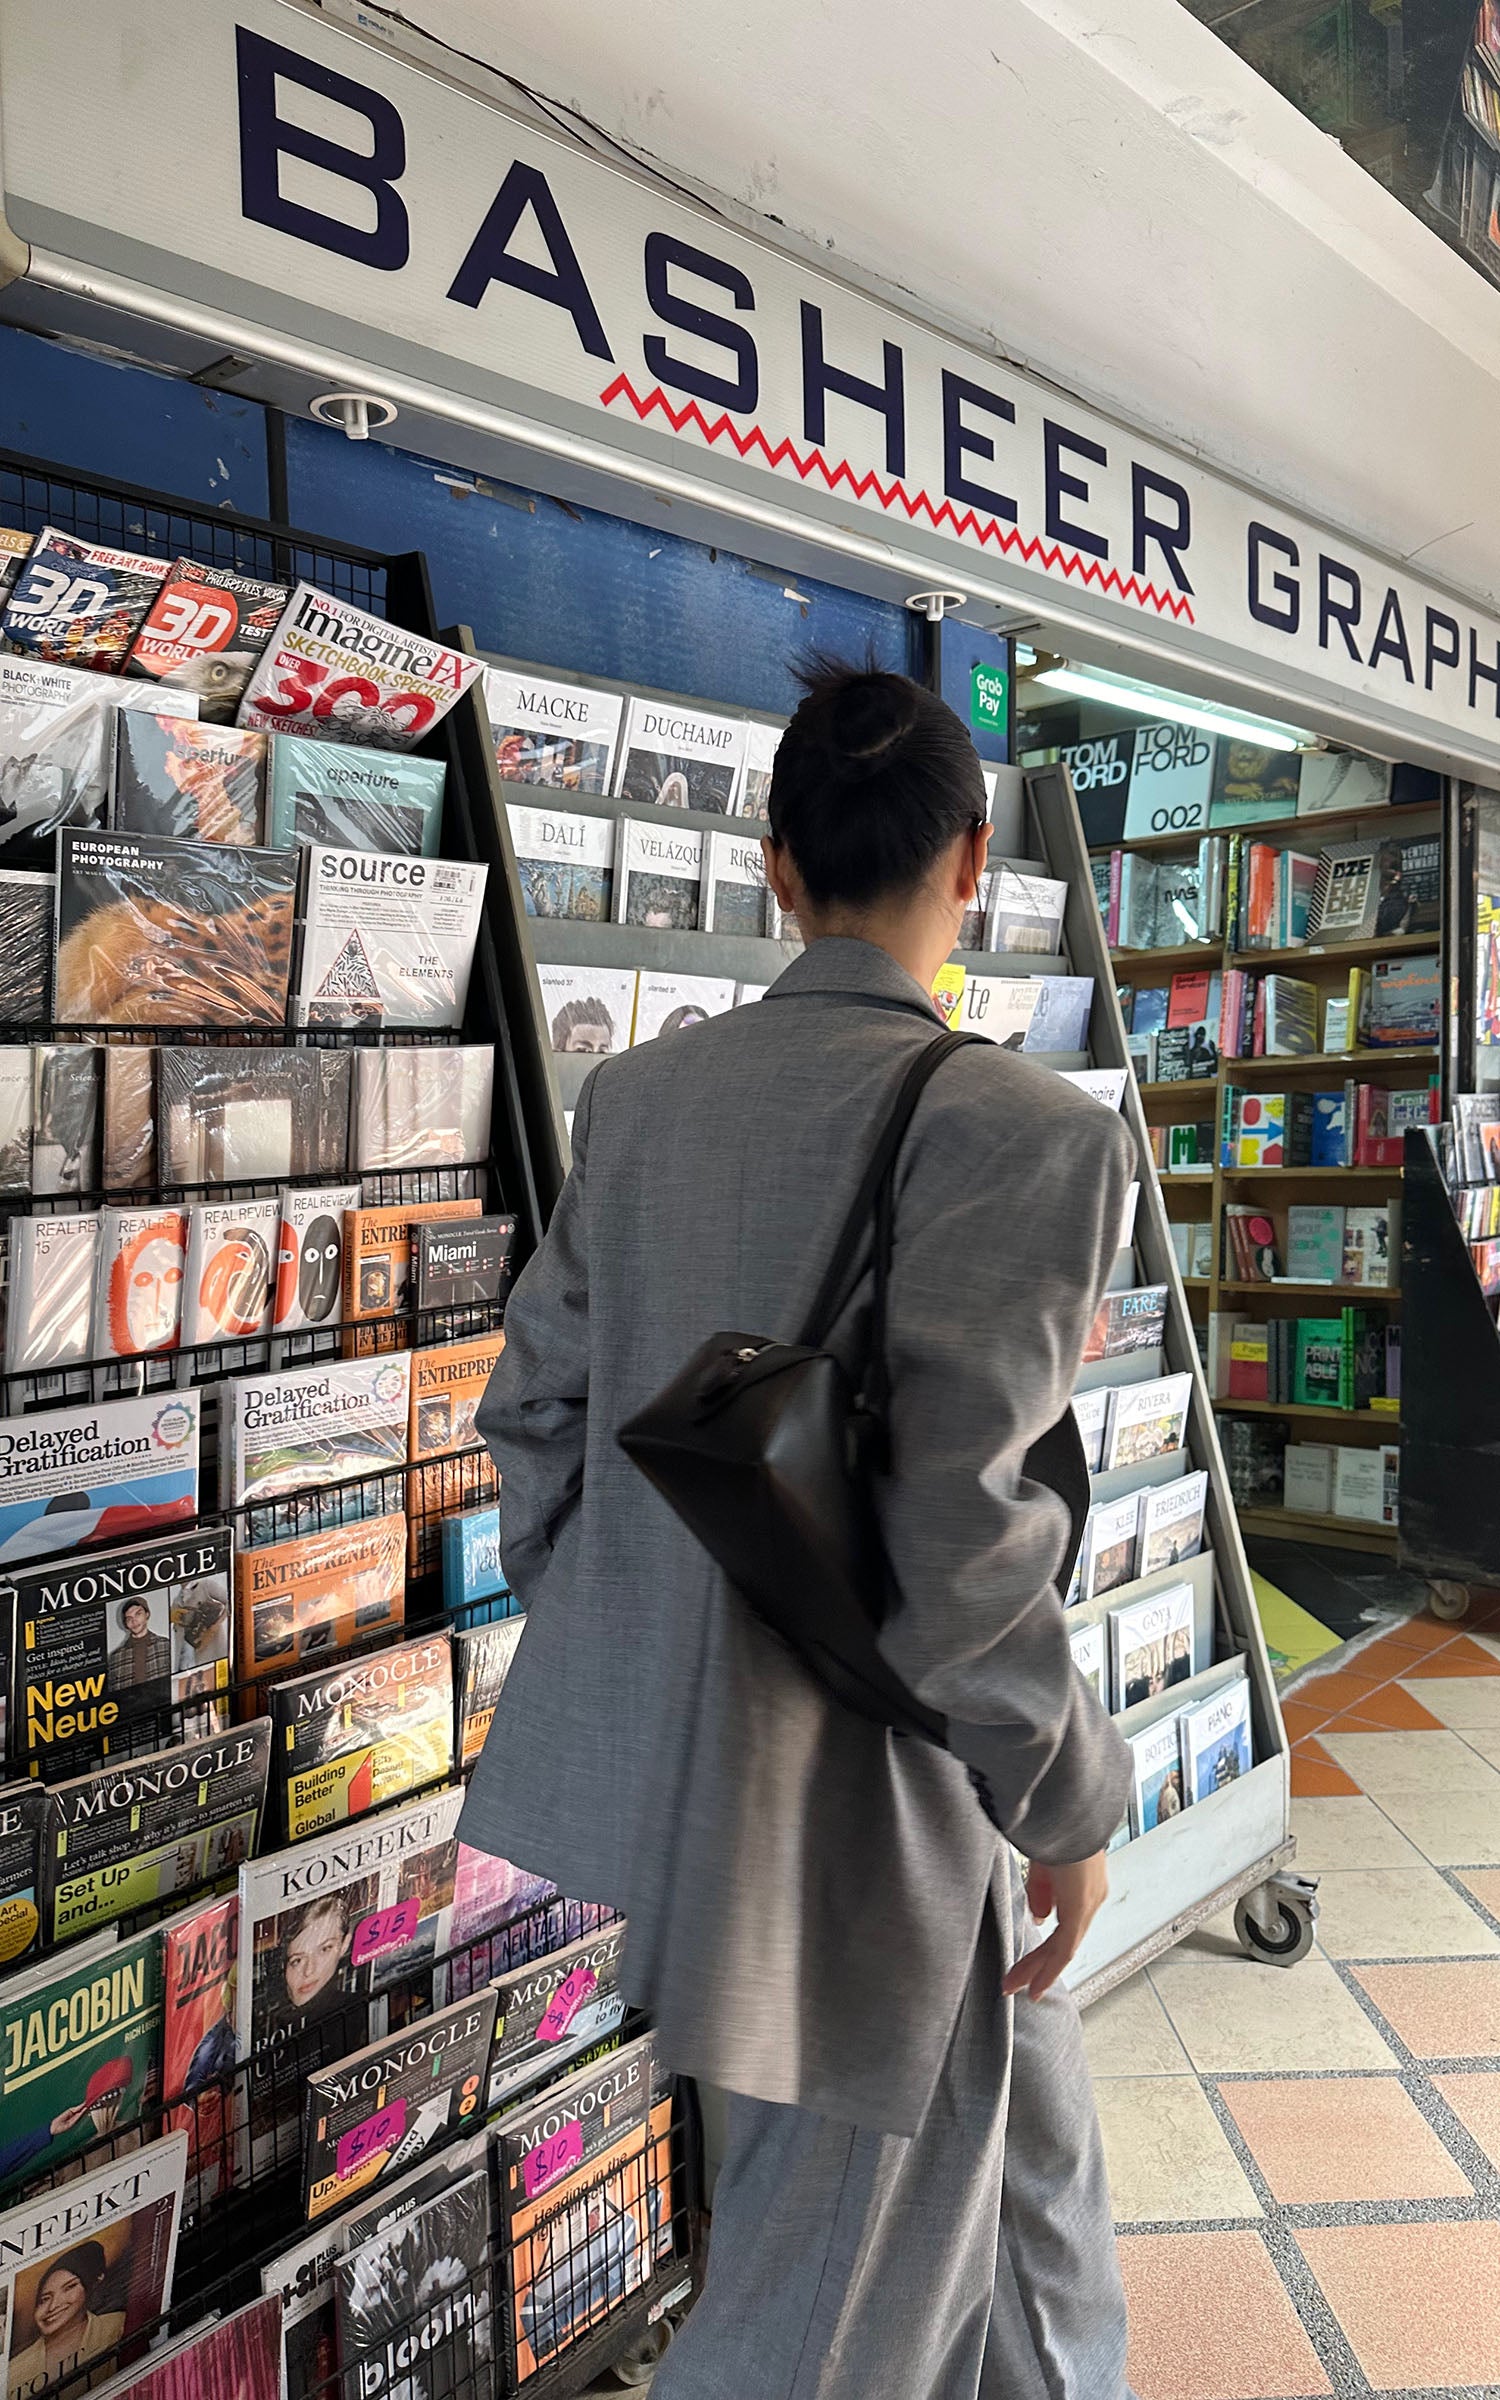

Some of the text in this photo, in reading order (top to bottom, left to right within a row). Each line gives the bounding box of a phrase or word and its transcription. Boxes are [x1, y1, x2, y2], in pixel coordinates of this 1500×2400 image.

[235, 24, 1500, 721] BASHEER GRAPH
[91, 550, 116, 566] FREE
[117, 555, 138, 571] ART
[139, 560, 172, 578] BOOKS
[7, 565, 109, 622] 3D
[9, 613, 66, 637] WORL
[140, 593, 232, 649] 3D
[239, 624, 273, 639] TEST
[339, 610, 439, 658] FOR DIGITAL ARTISTS
[278, 655, 300, 671] OVER
[283, 631, 457, 704] SKETCHBOOK SPECIAL!
[2, 681, 72, 701] PHOTOGRAPHY
[976, 673, 1003, 696] Grab
[517, 690, 589, 723] MACKE
[979, 691, 1000, 716] Pay
[247, 713, 320, 738] NEW SKETCHES!
[642, 714, 733, 749] DUCHAMP
[1138, 722, 1197, 752] TOM
[1061, 738, 1118, 766] TOM
[1135, 741, 1210, 776] FORD
[326, 767, 400, 790] aperture
[1069, 760, 1127, 792] ORD
[1151, 803, 1202, 832] 002
[541, 822, 585, 848] DALÍ
[72, 841, 139, 856] EUROPEAN
[71, 854, 164, 870] PHOTOGRAPHY
[320, 853, 426, 887] source
[319, 884, 349, 894] THINKING
[350, 887, 379, 897] THROUGH
[399, 967, 453, 979] ELEMENTS
[418, 955, 438, 966] THE
[542, 978, 565, 987] slanted
[967, 979, 991, 1020] te
[204, 1203, 281, 1224] REAL REVIEW
[294, 1194, 354, 1211] REAL REVIEW
[36, 1221, 76, 1236] REAL
[118, 1218, 151, 1233] REAL
[293, 1214, 304, 1226] 12
[361, 1217, 378, 1228] The
[35, 1241, 50, 1254] 15
[118, 1237, 132, 1250] 14
[203, 1228, 217, 1241] 13
[361, 1224, 410, 1246] ENTRE
[438, 1231, 462, 1240] MONOCLE
[428, 1241, 477, 1263] Miami
[418, 1357, 436, 1371] The
[245, 1378, 330, 1410] Delayed
[1138, 1392, 1171, 1412] RIVERA
[244, 1392, 370, 1429] Gratification
[0, 1420, 100, 1456] Delayed
[0, 1437, 151, 1478] Gratification
[252, 1557, 275, 1572] The
[38, 1547, 217, 1614] MONOCLE
[1142, 1606, 1171, 1631] GOYA
[26, 1640, 85, 1664] Get inspired
[297, 1645, 441, 1718] MONOCLE
[27, 1673, 106, 1717] New
[28, 1701, 120, 1749] Neue
[467, 1713, 492, 1731] Tim
[1208, 1702, 1232, 1731] PIANO
[72, 1738, 254, 1823] MONOCLE
[295, 1765, 346, 1794] Building
[295, 1783, 334, 1809] Better
[88, 1848, 107, 1863] talk
[108, 1841, 131, 1857] shop
[143, 1828, 163, 1845] why
[178, 1814, 198, 1829] time
[199, 1811, 208, 1821] to
[209, 1797, 243, 1816] smarten
[244, 1793, 256, 1805] up
[295, 1810, 336, 1836] Global
[281, 1813, 439, 1898] KONFEKT
[59, 1865, 131, 1904] Set Up
[1, 1903, 18, 1918] Art
[58, 1895, 115, 1926] and...
[258, 1924, 269, 1939] 1.
[4, 1958, 144, 2076] JACOBIN
[596, 2002, 623, 2025] to fly
[124, 2026, 143, 2044] RICH
[332, 2011, 482, 2109] MONOCLE
[519, 2061, 640, 2158] MONOCLE
[346, 2117, 391, 2161] $10
[534, 2139, 567, 2183] $10
[313, 2178, 337, 2199] Up,
[534, 2151, 628, 2228] Heading in the
[0, 2169, 150, 2267] NFEKT
[156, 2197, 172, 2217] 2.
[396, 2197, 417, 2217] PLUS
[317, 2244, 337, 2263] PLUS
[359, 2291, 478, 2399] bloom
[11, 2370, 48, 2400] TO
